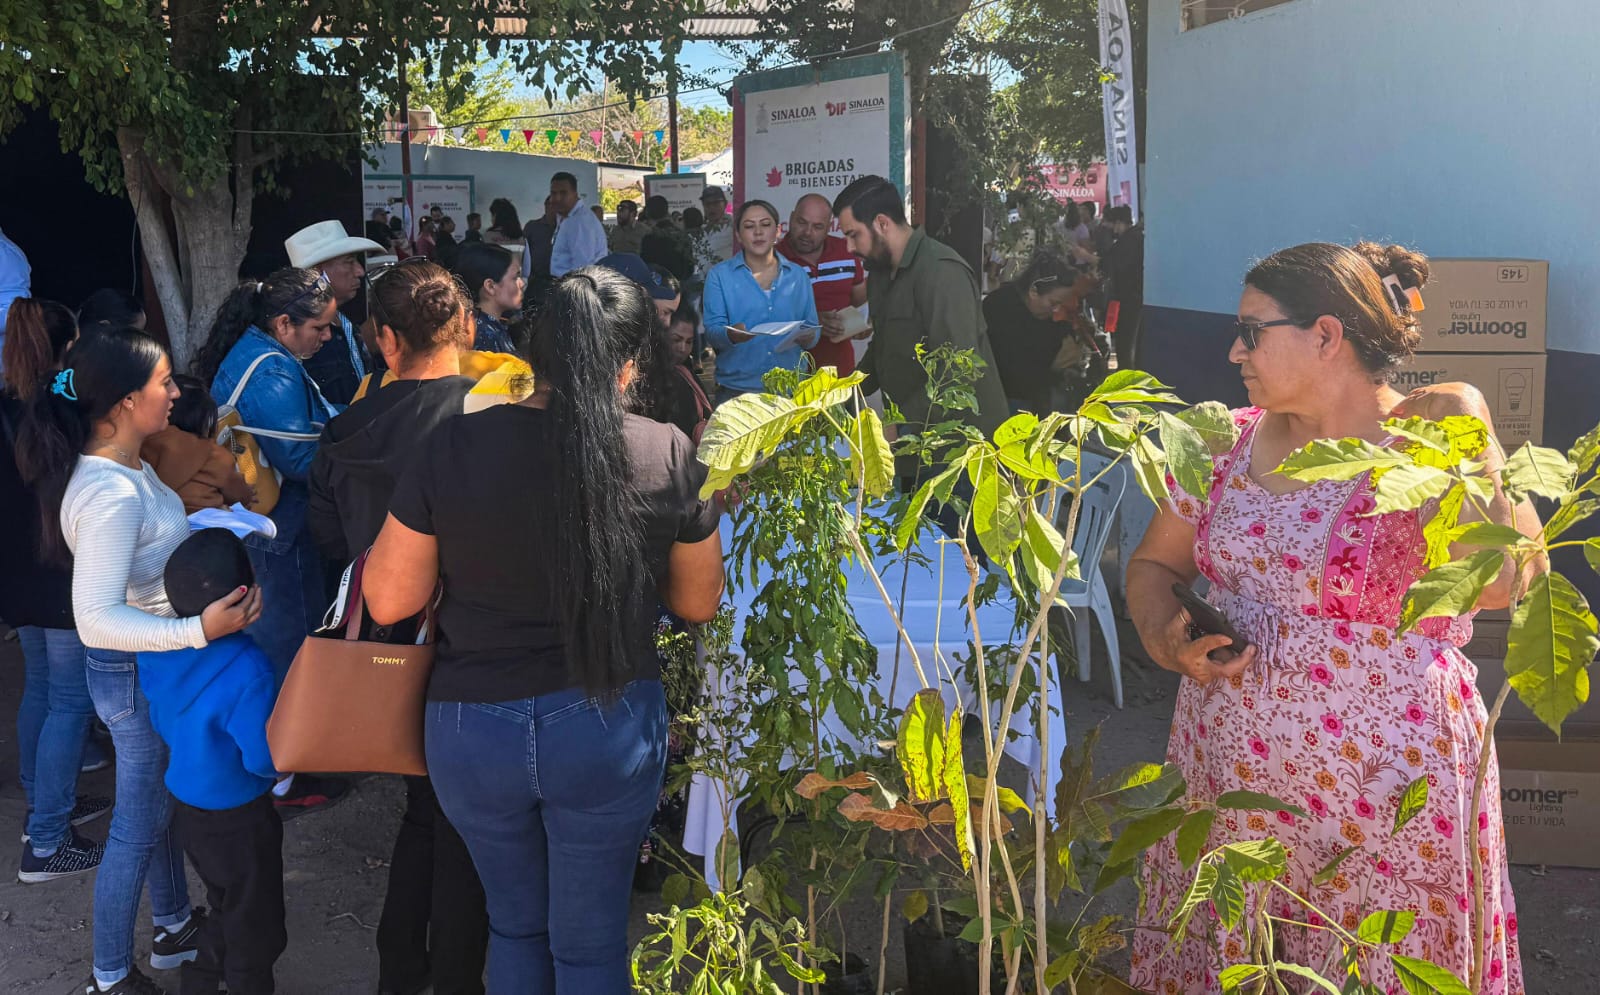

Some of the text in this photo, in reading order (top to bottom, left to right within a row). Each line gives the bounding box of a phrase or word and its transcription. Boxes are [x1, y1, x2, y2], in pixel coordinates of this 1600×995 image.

[849, 97, 885, 109] SINALOA
[771, 106, 817, 121] SINALOA
[785, 158, 855, 177] BRIGADAS
[1054, 188, 1095, 198] SINALOA
[1501, 269, 1523, 280] 145
[1449, 300, 1528, 309] LA LUZ DE TU VIDA
[1451, 312, 1481, 321] Lighting
[1448, 321, 1527, 339] Boomer
[372, 656, 406, 665] TOMMY
[1529, 803, 1563, 814] Lighting
[1512, 815, 1525, 825] DE
[1528, 815, 1540, 826] TU
[1543, 816, 1566, 827] VIDA
